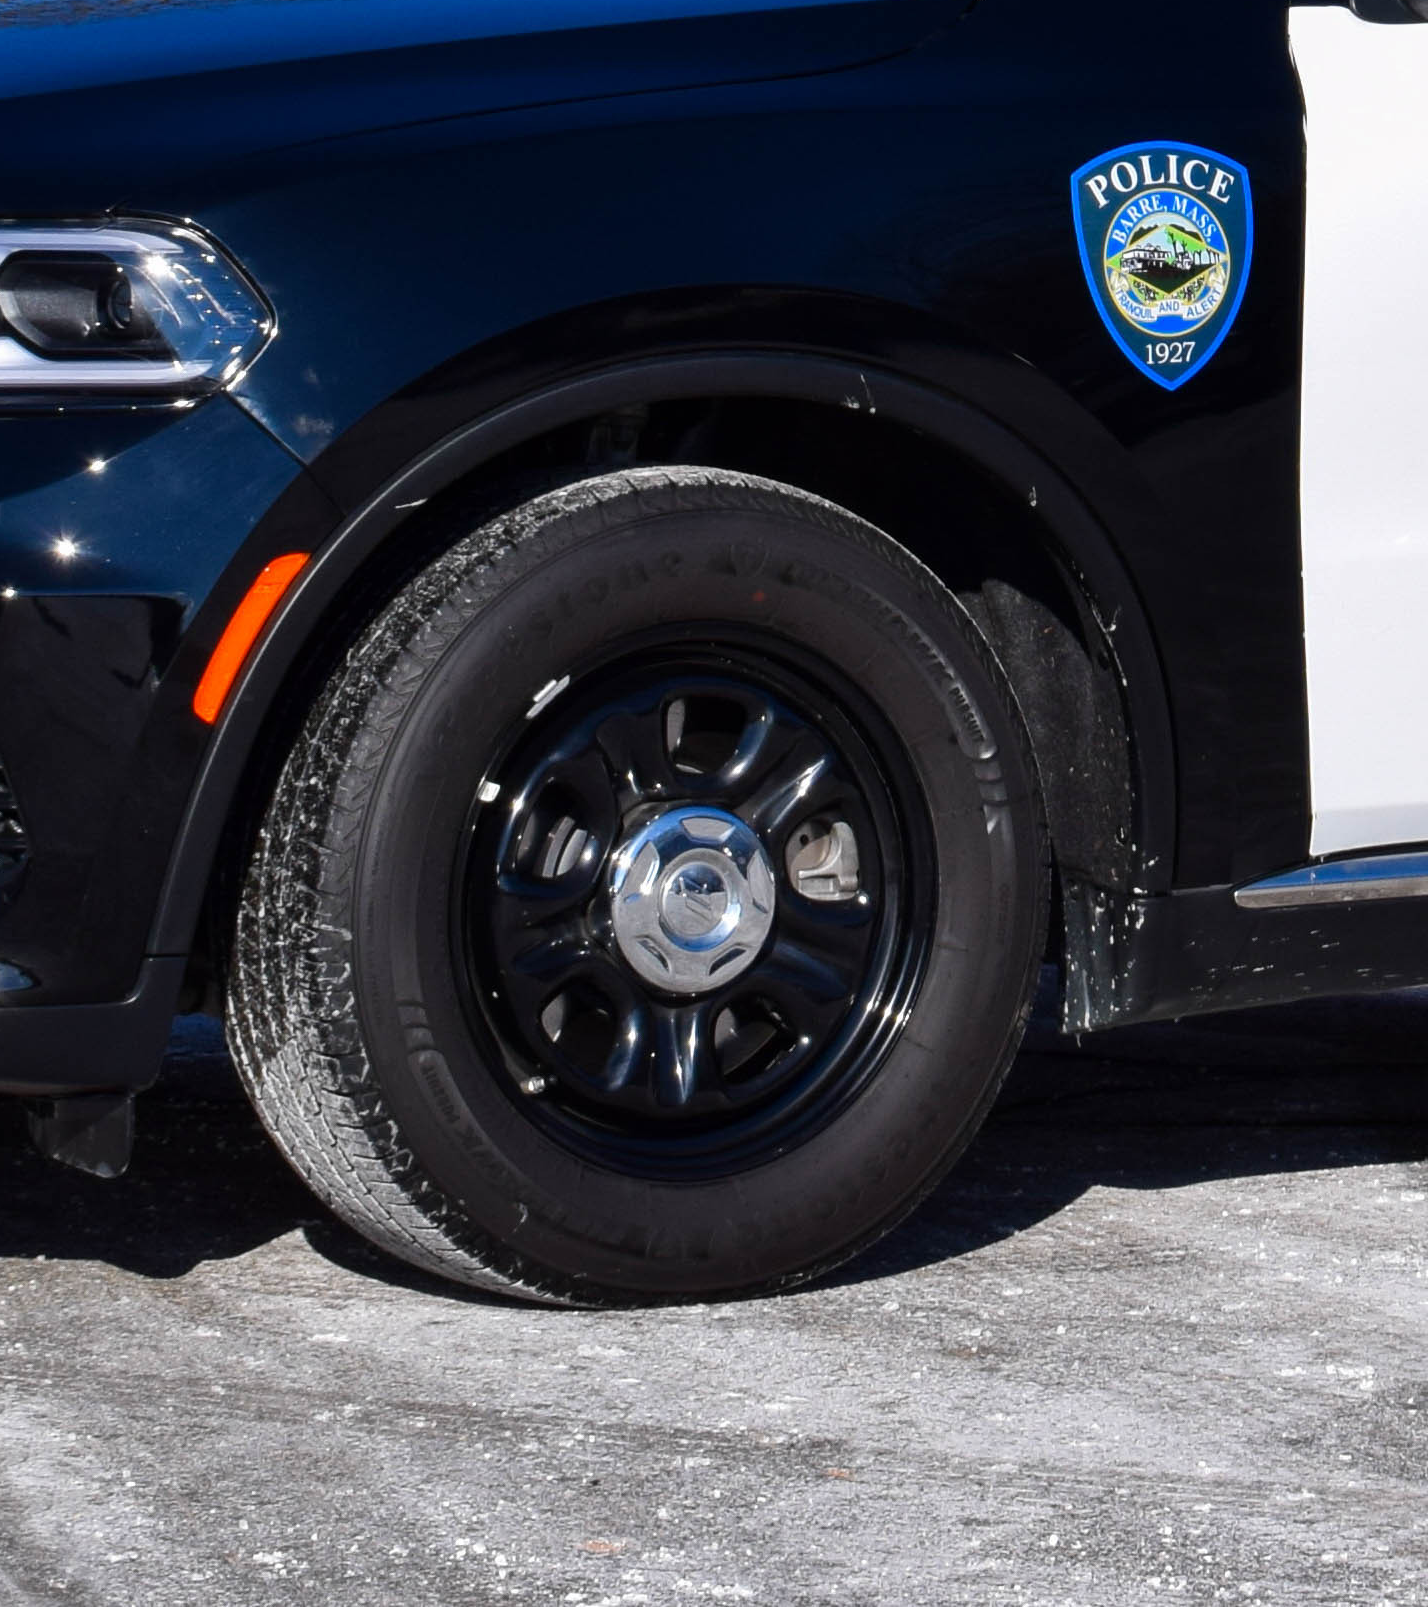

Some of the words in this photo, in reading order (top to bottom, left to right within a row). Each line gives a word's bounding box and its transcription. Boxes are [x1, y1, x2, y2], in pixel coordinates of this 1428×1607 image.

[1085, 154, 1235, 209] POLICE
[1112, 194, 1169, 245] BARRE,
[1172, 196, 1218, 242] MASS.
[1115, 289, 1155, 319] TRANQUIL
[1159, 300, 1180, 312] AND
[1186, 287, 1222, 316] ALERT
[1145, 341, 1196, 365] 1927
